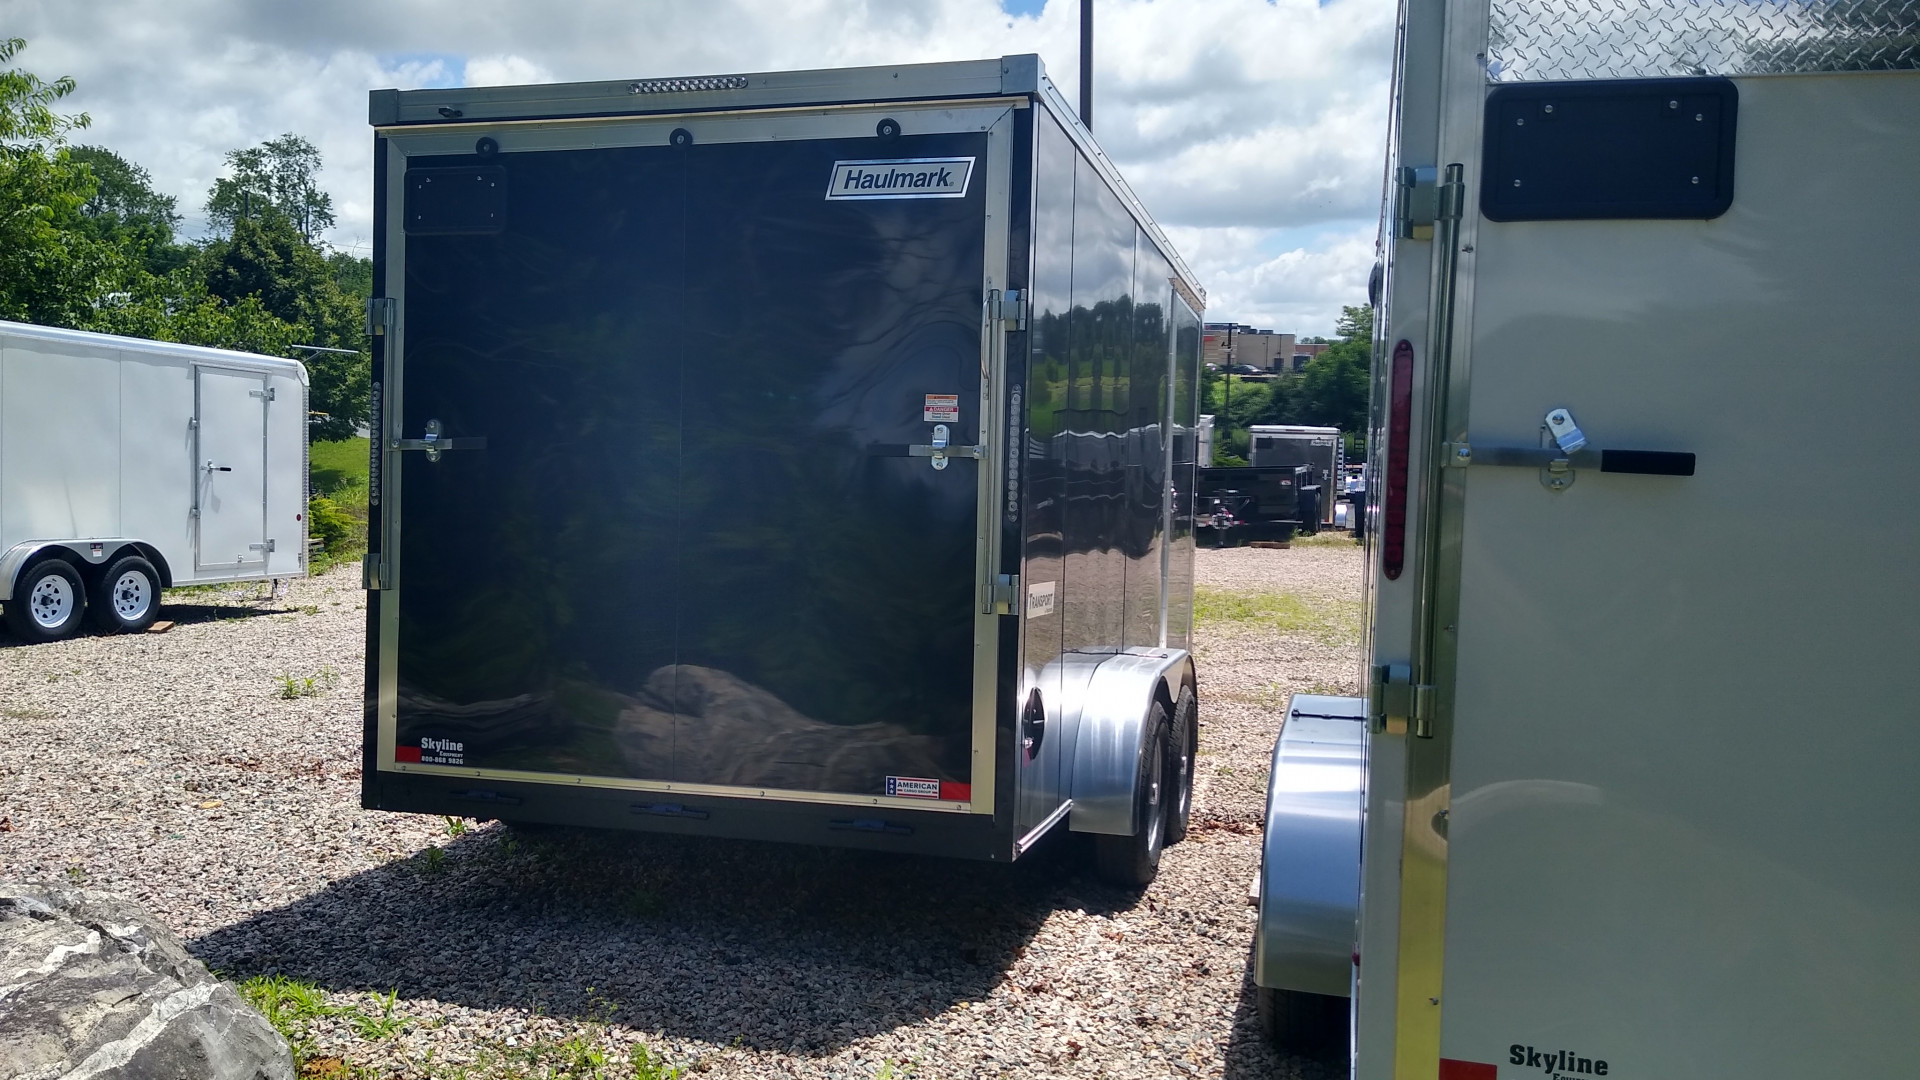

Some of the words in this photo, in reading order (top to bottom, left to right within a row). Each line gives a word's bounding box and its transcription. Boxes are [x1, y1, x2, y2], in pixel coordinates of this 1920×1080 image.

[843, 167, 952, 190] Haulmark
[421, 737, 463, 752] Skyline
[897, 782, 938, 790] AMERICAN
[1509, 1044, 1608, 1076] Skyline
